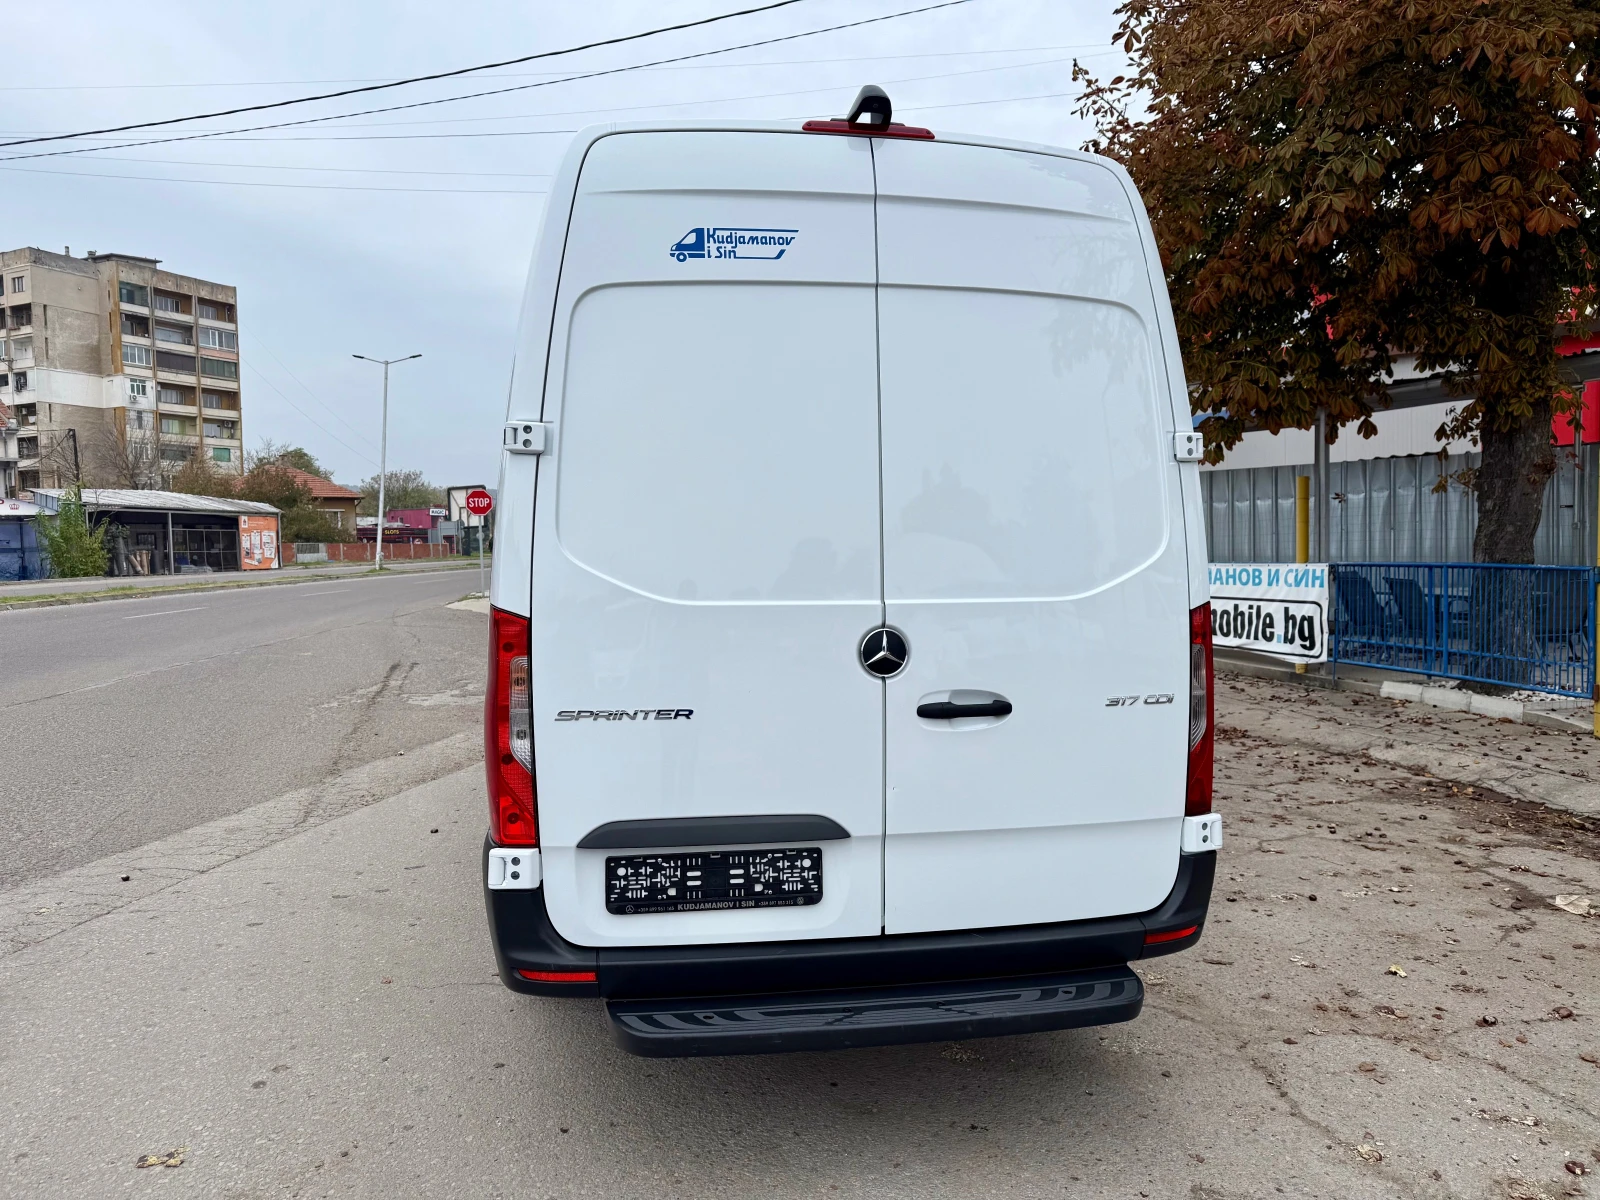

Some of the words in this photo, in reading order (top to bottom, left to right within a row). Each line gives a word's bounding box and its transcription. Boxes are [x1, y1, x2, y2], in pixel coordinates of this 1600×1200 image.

[706, 228, 796, 248] Kudjamanov
[714, 246, 737, 259] Sin
[468, 498, 490, 508] STOP
[1267, 568, 1280, 587] И
[1284, 568, 1325, 588] СИН
[1105, 695, 1140, 707] 317
[554, 709, 694, 721] SPRINTER
[677, 901, 734, 911] KUDJAMANOV
[741, 900, 755, 908] SIN
